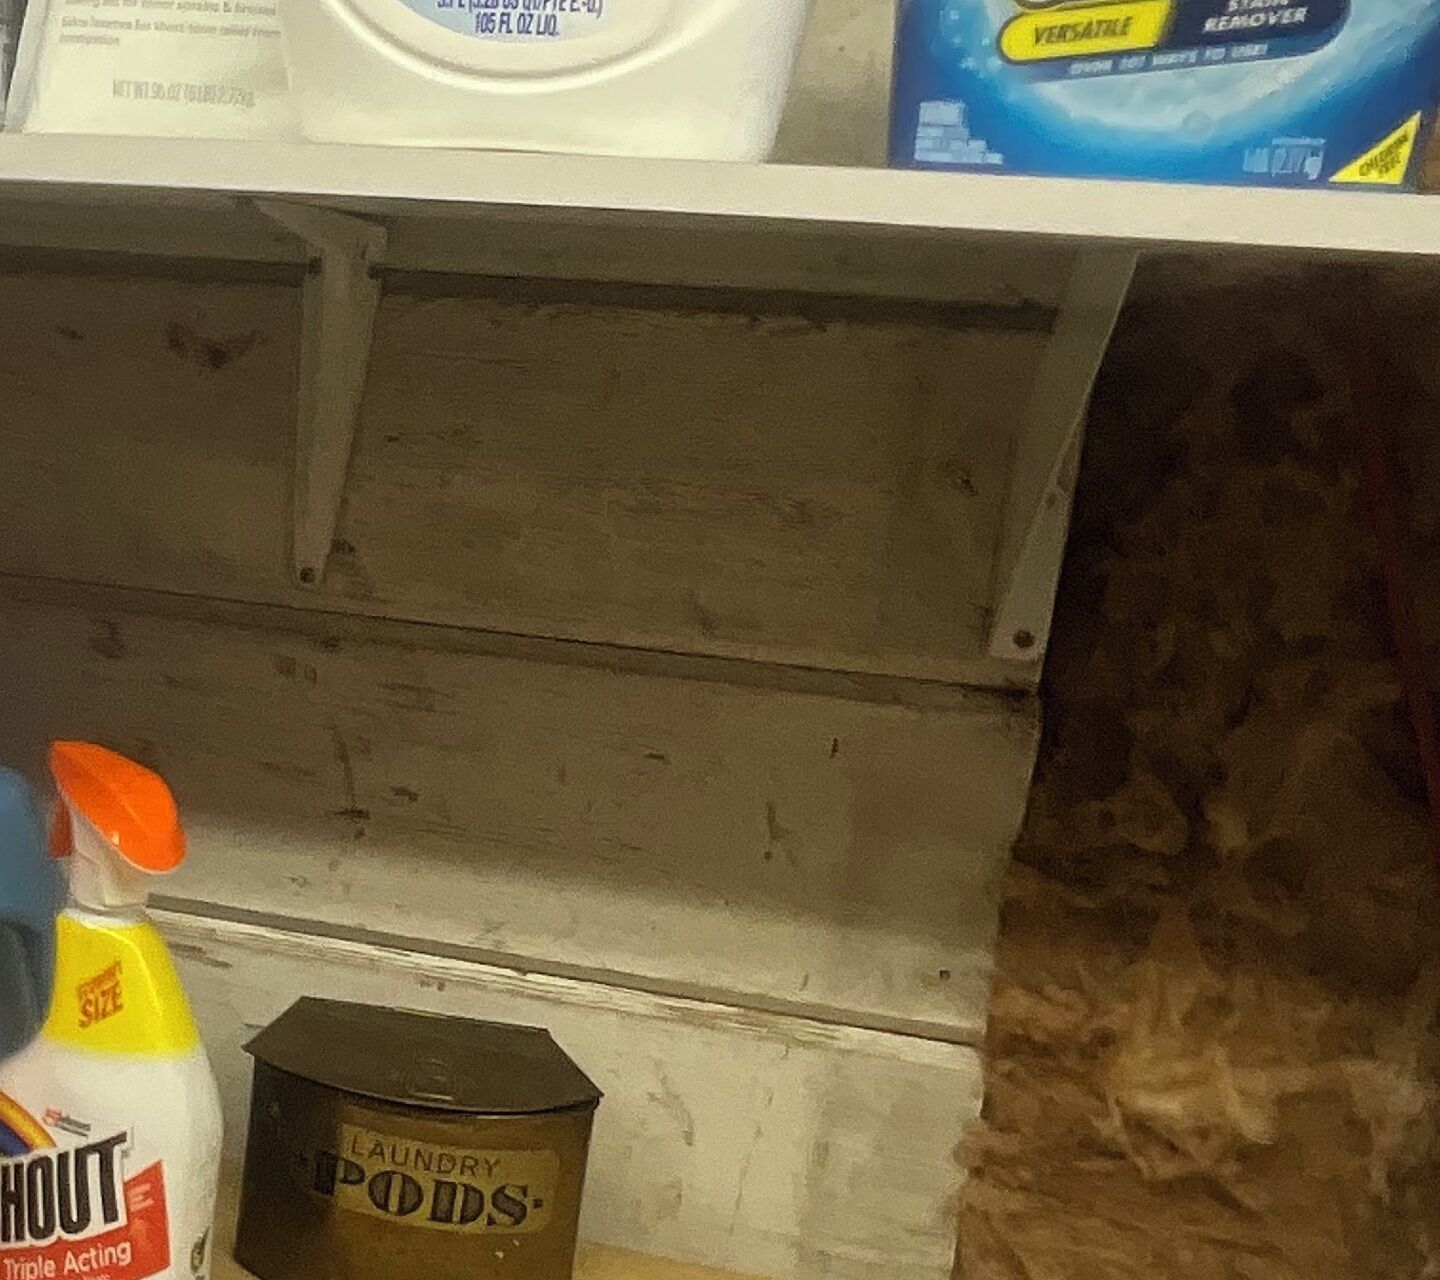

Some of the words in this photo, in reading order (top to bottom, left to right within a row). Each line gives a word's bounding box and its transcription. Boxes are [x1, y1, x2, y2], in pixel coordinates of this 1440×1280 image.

[475, 12, 496, 34] 105
[516, 14, 533, 34] OZ
[1035, 16, 1133, 45] VERSATILE
[1203, 7, 1309, 33] REMOVER
[78, 979, 124, 1030] SIZE
[349, 1137, 501, 1178] LAUNDRY
[313, 1150, 530, 1227] PODS
[63, 1241, 132, 1276] Acting
